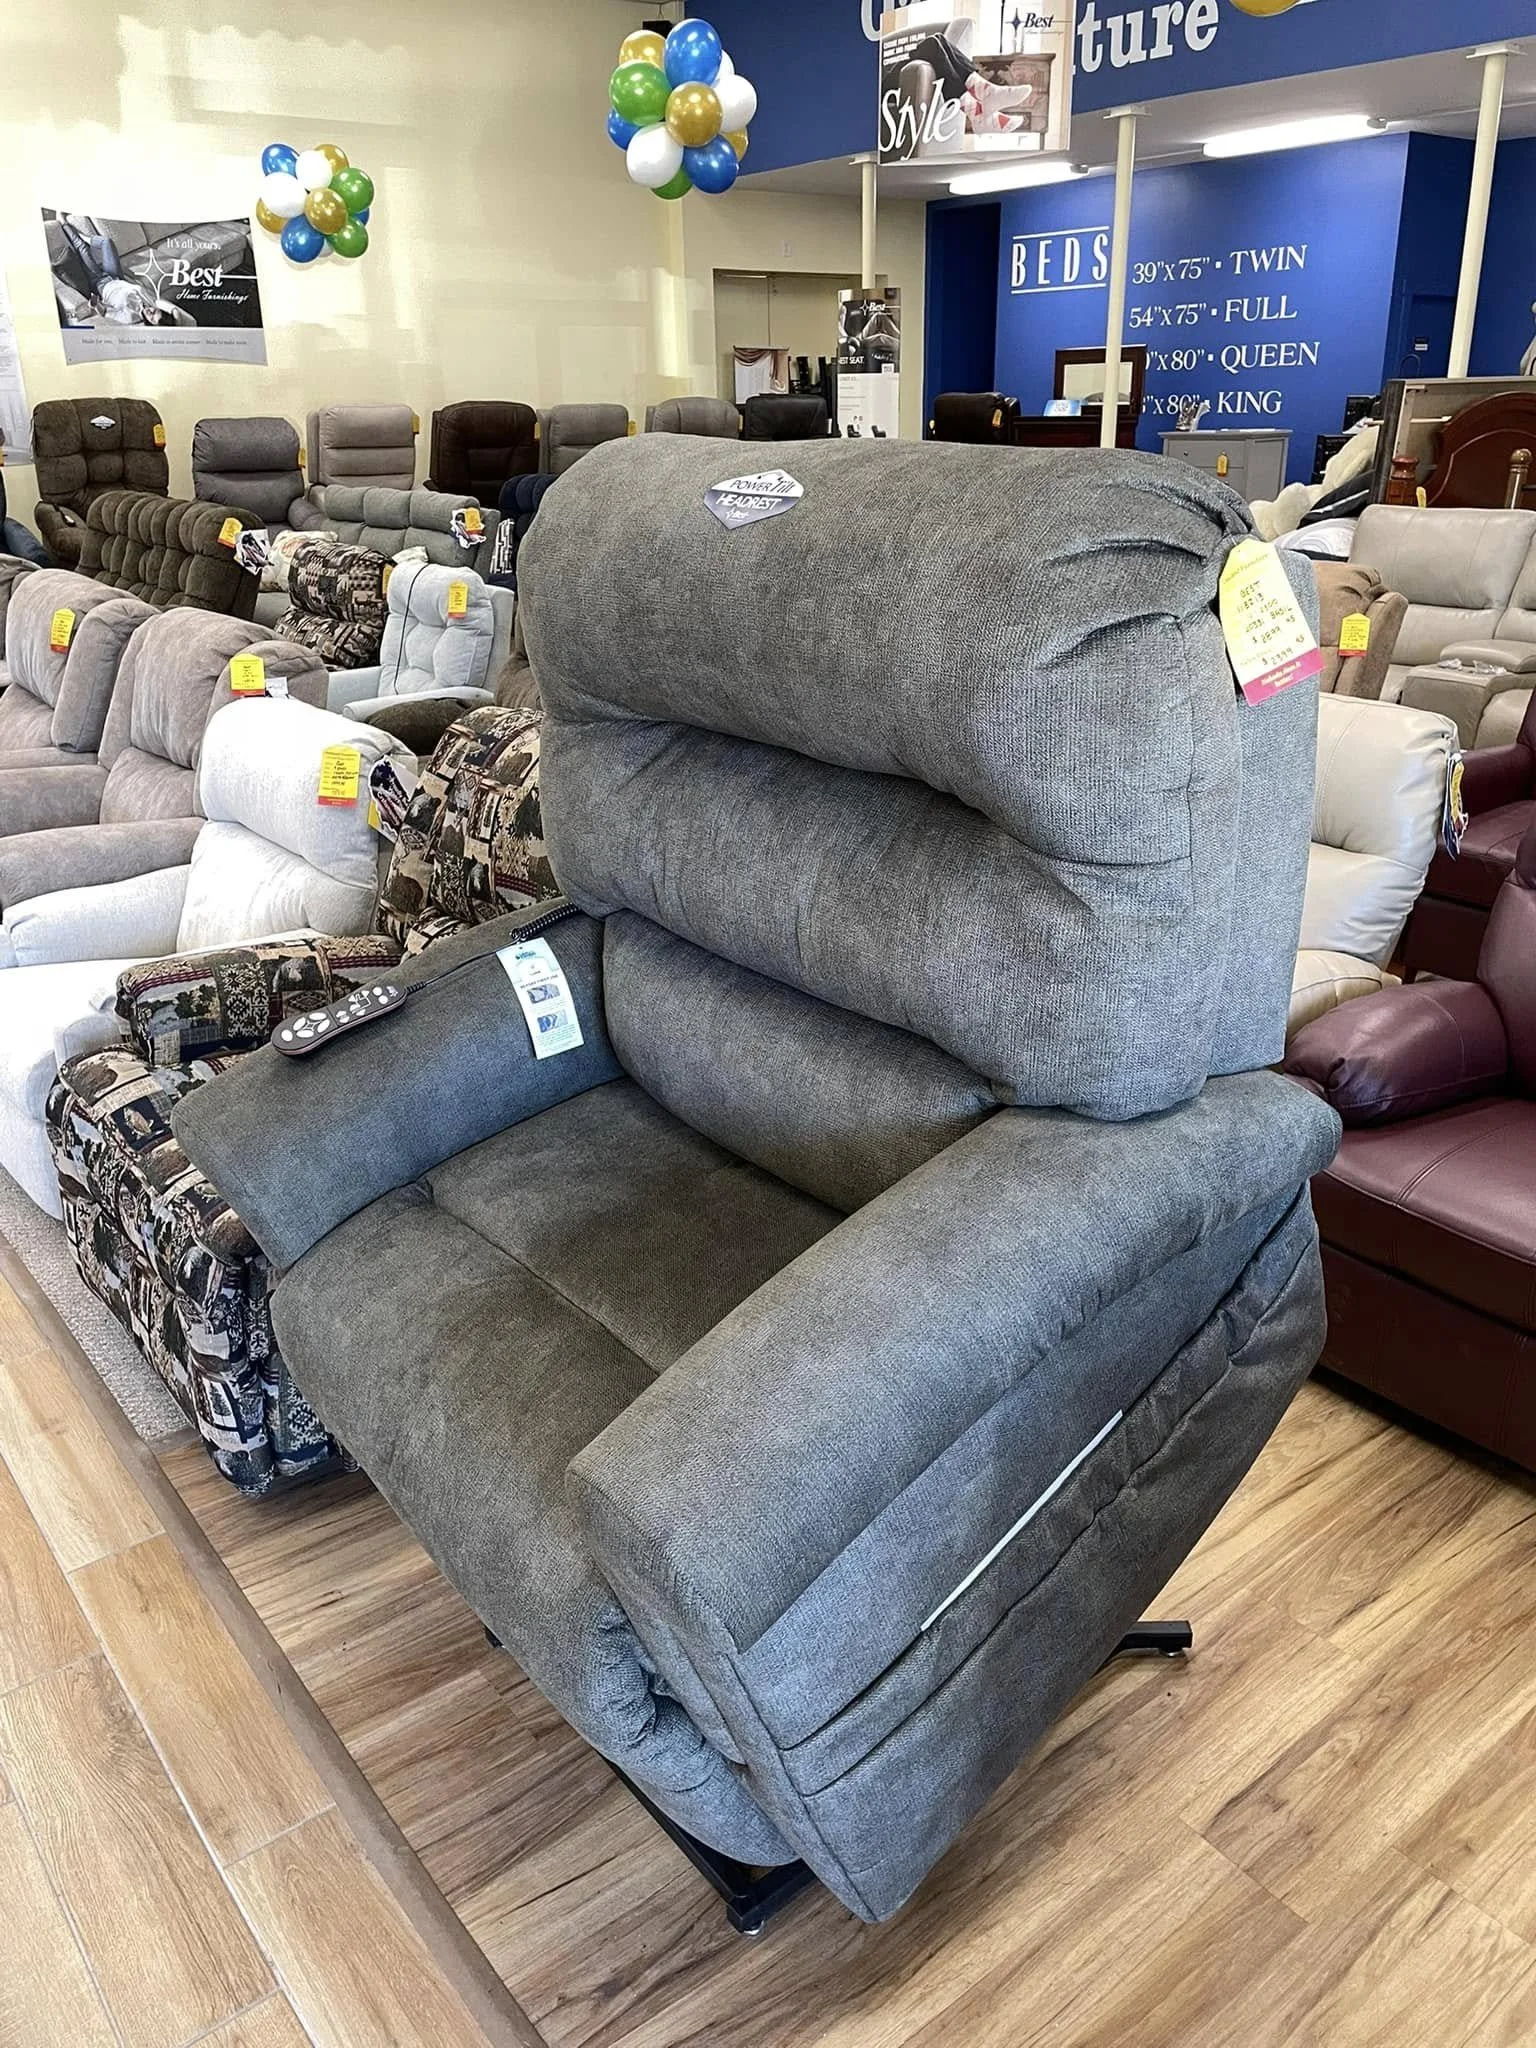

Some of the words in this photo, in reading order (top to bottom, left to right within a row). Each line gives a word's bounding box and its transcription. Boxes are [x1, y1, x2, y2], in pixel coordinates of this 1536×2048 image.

[1024, 12, 1054, 29] Best
[1072, 0, 1218, 74] ture
[879, 78, 961, 161] Style
[166, 238, 181, 249] It's
[181, 238, 193, 249] all
[194, 241, 222, 252] yours.
[169, 258, 223, 288] Best
[1011, 233, 1109, 288] BEDS
[1229, 245, 1308, 275] TWIN
[1224, 295, 1298, 322] FULL
[1220, 341, 1321, 374] QUEEN
[1217, 390, 1283, 415] KING
[730, 479, 773, 492] POWER
[715, 493, 783, 511] HEADREST
[1239, 580, 1261, 599] BEST
